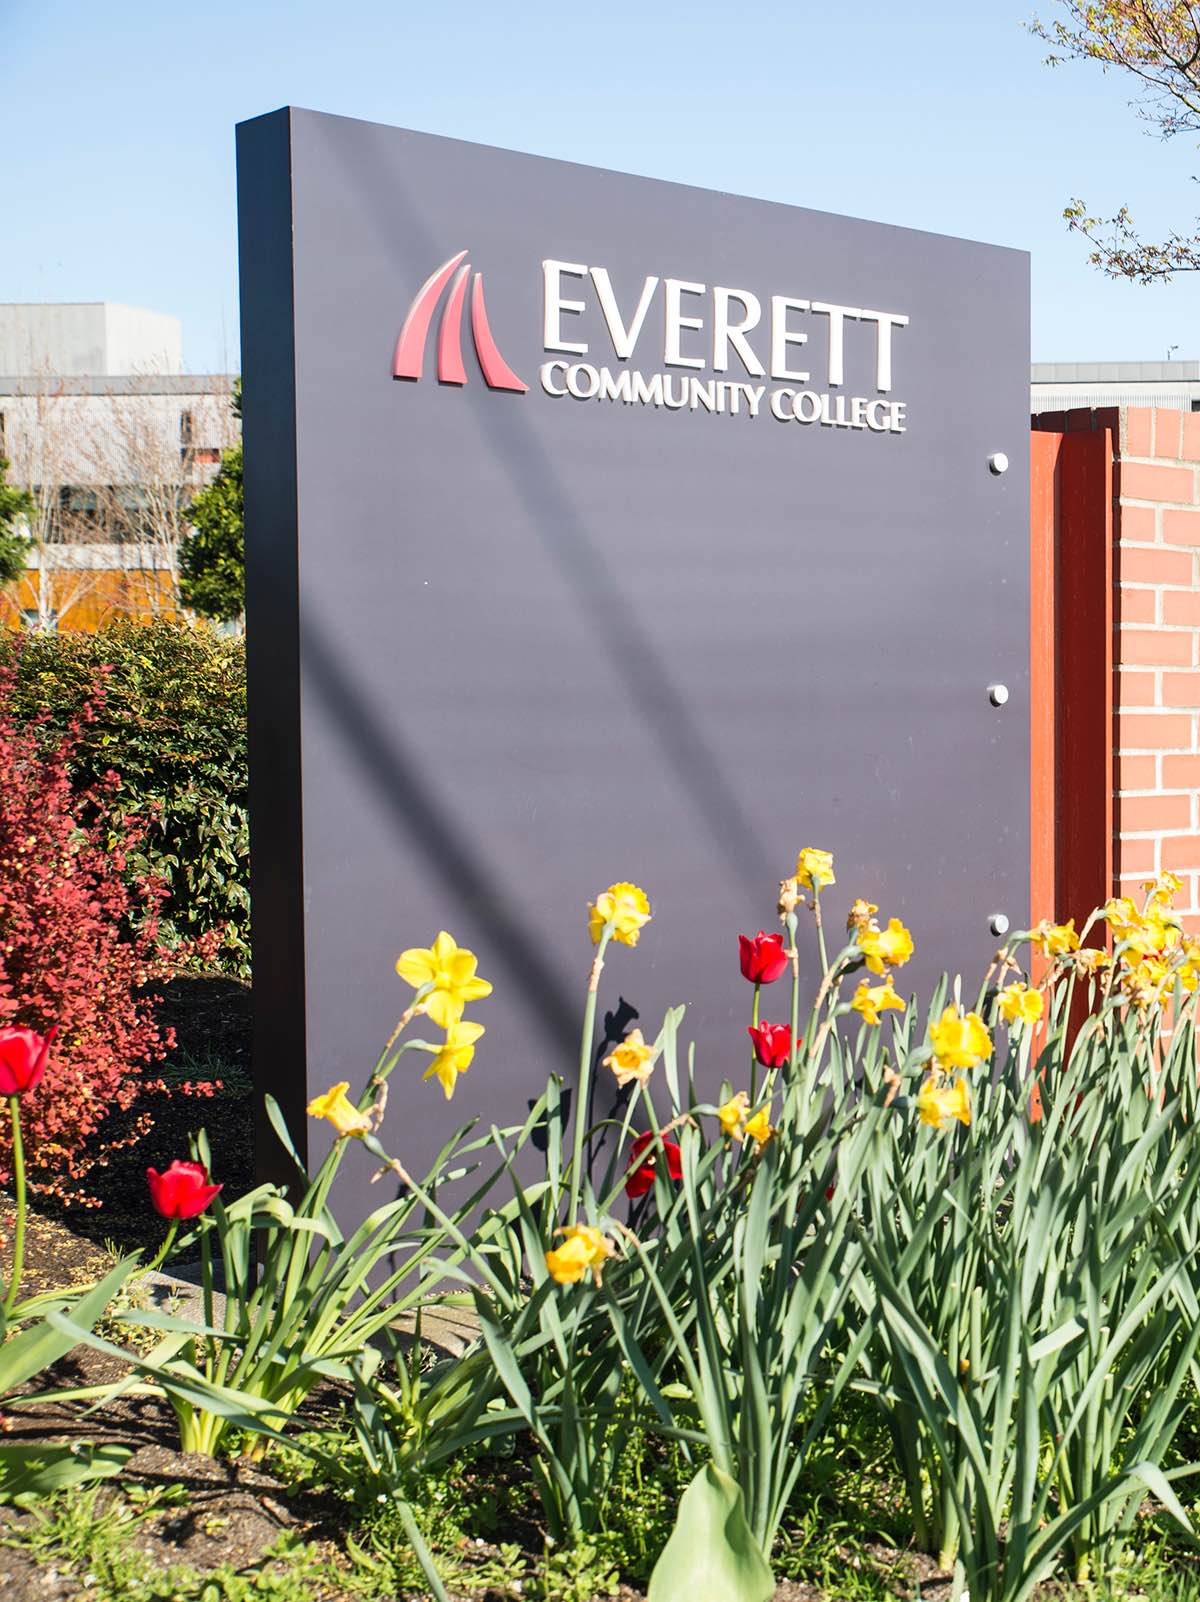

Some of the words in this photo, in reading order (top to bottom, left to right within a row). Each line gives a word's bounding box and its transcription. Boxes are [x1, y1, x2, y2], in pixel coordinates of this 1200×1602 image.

[542, 259, 909, 391] EVERETT
[541, 361, 766, 415] COMMUNITY
[771, 388, 907, 431] COLLEGE
